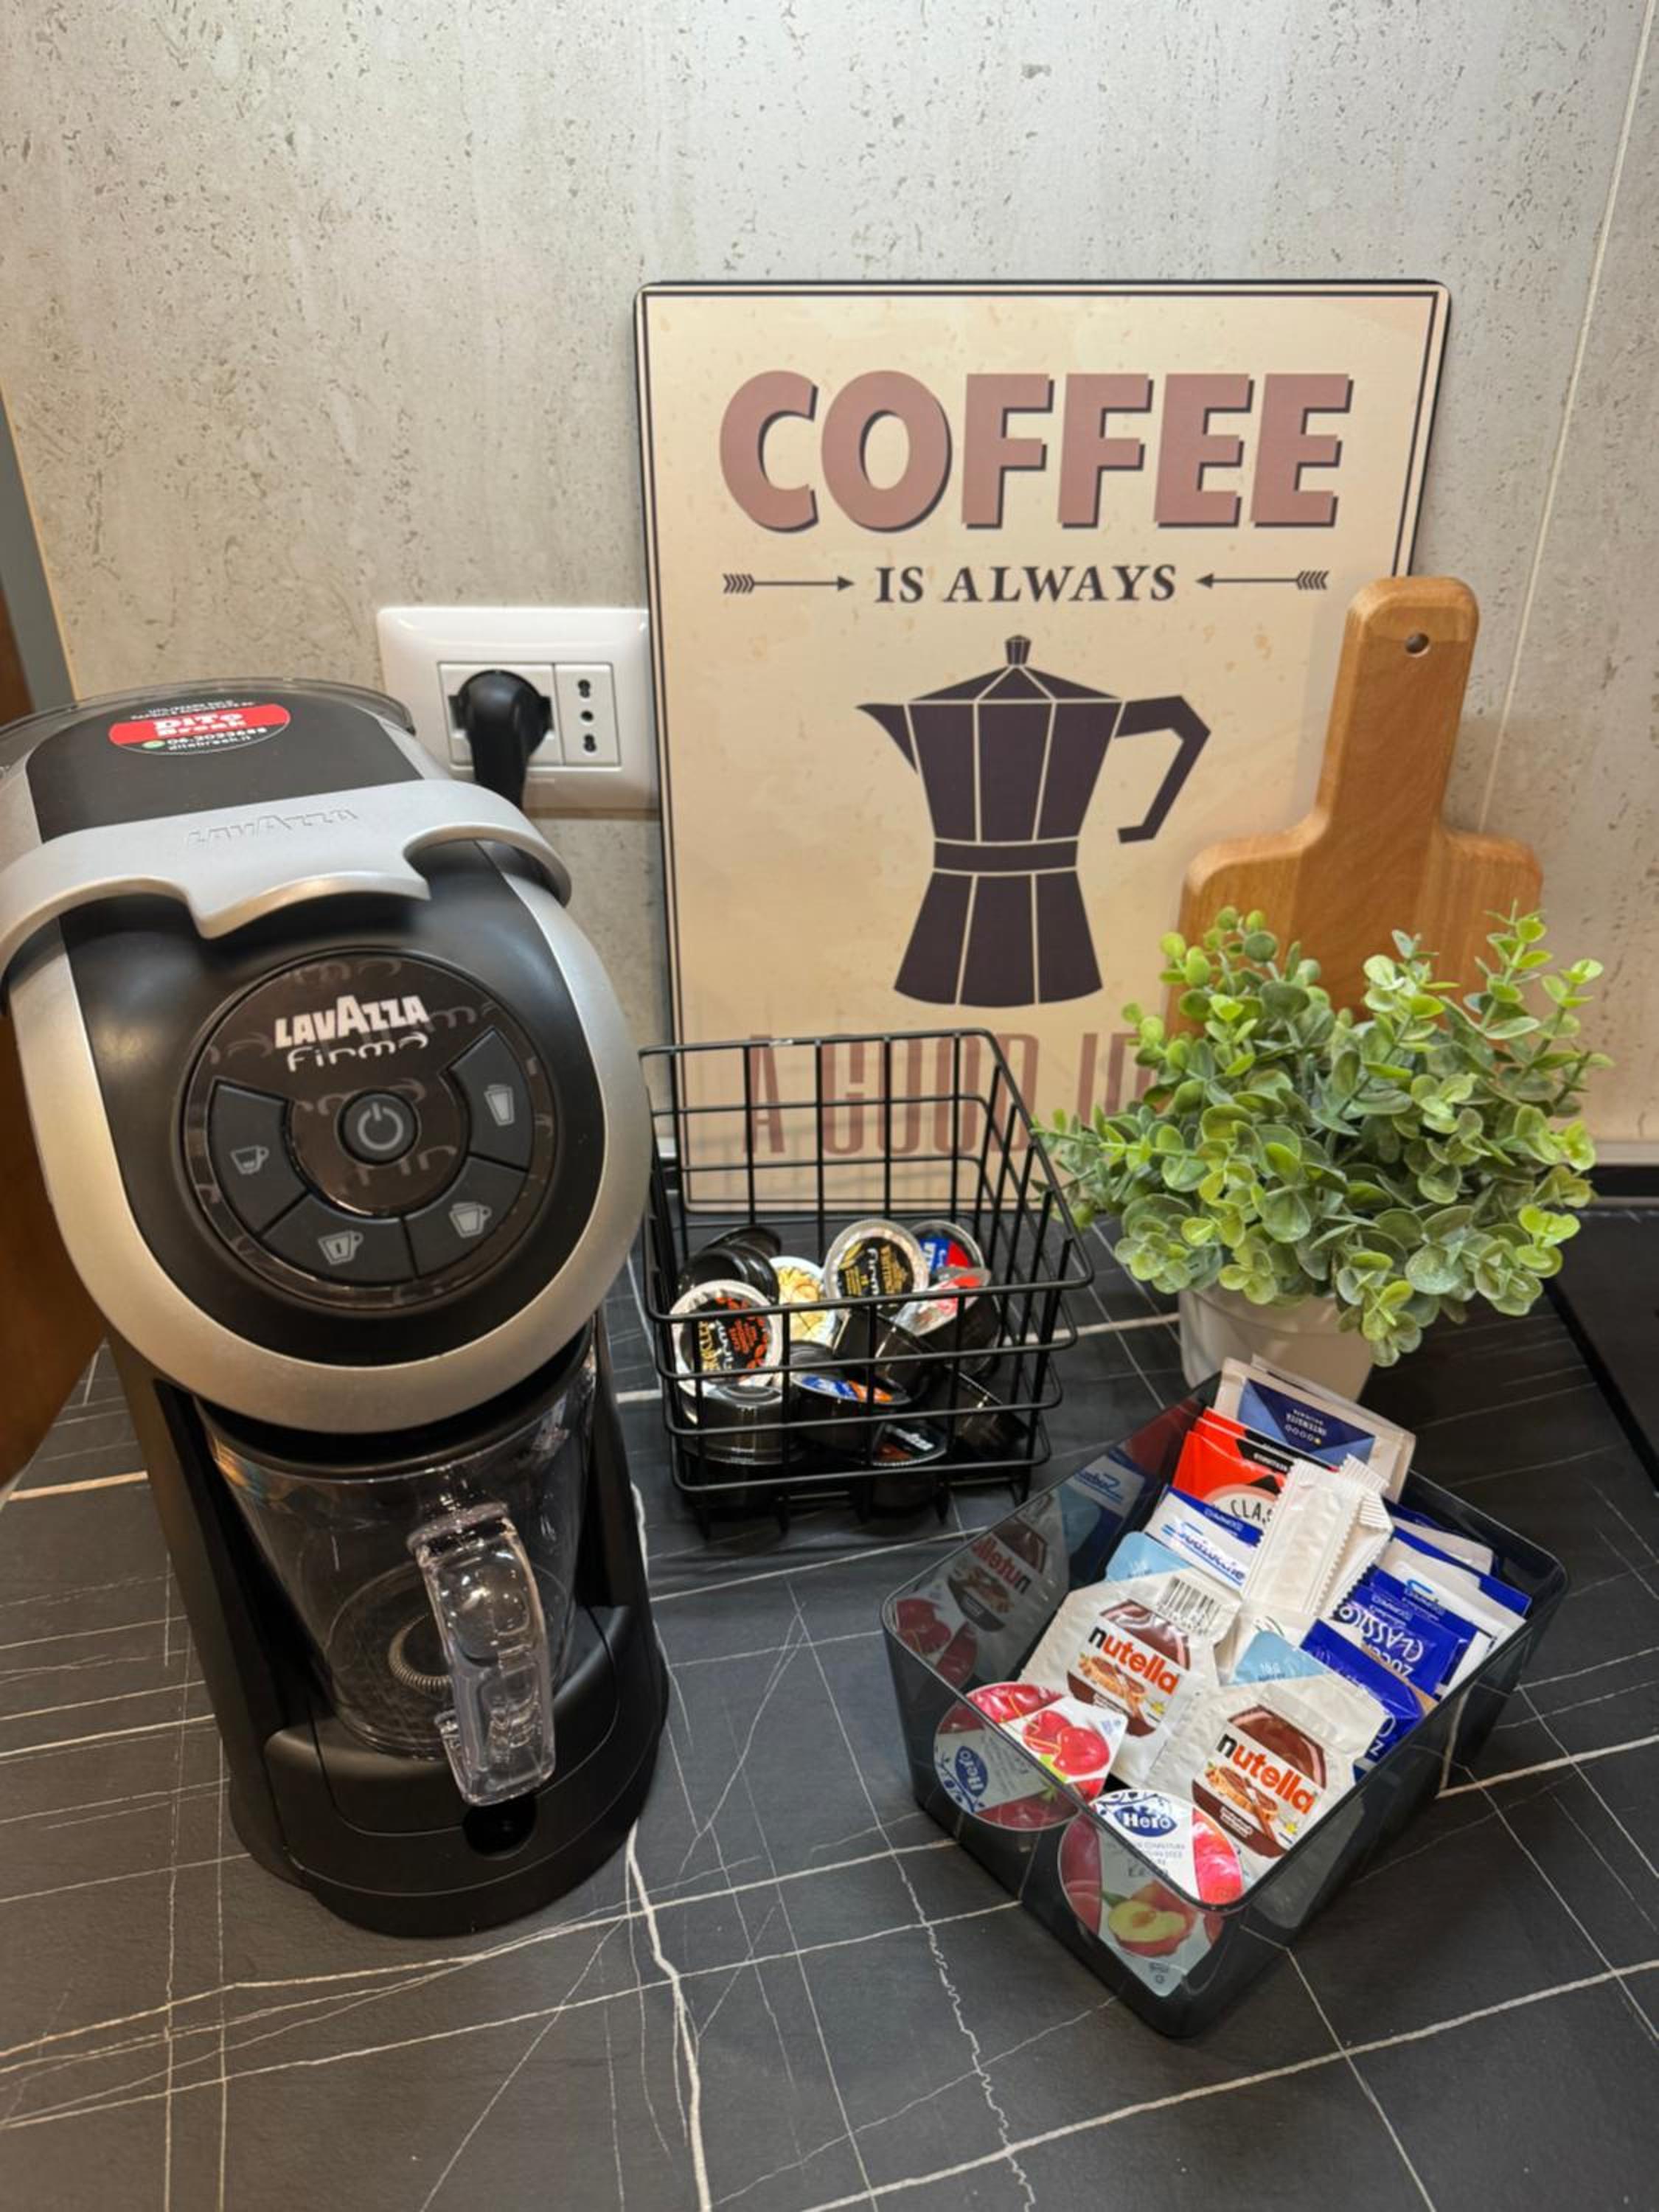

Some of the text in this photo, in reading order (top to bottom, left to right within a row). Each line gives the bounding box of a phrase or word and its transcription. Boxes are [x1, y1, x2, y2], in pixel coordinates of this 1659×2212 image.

[720, 369, 1354, 533] COFFEE
[875, 565, 1177, 603] IS ALWAYS
[274, 994, 431, 1048] LAVAZZA
[1088, 1627, 1181, 1695] nutella
[956, 1750, 984, 1792] Hero
[1217, 1733, 1317, 1815] nutella
[1121, 1812, 1173, 1831] Hero
